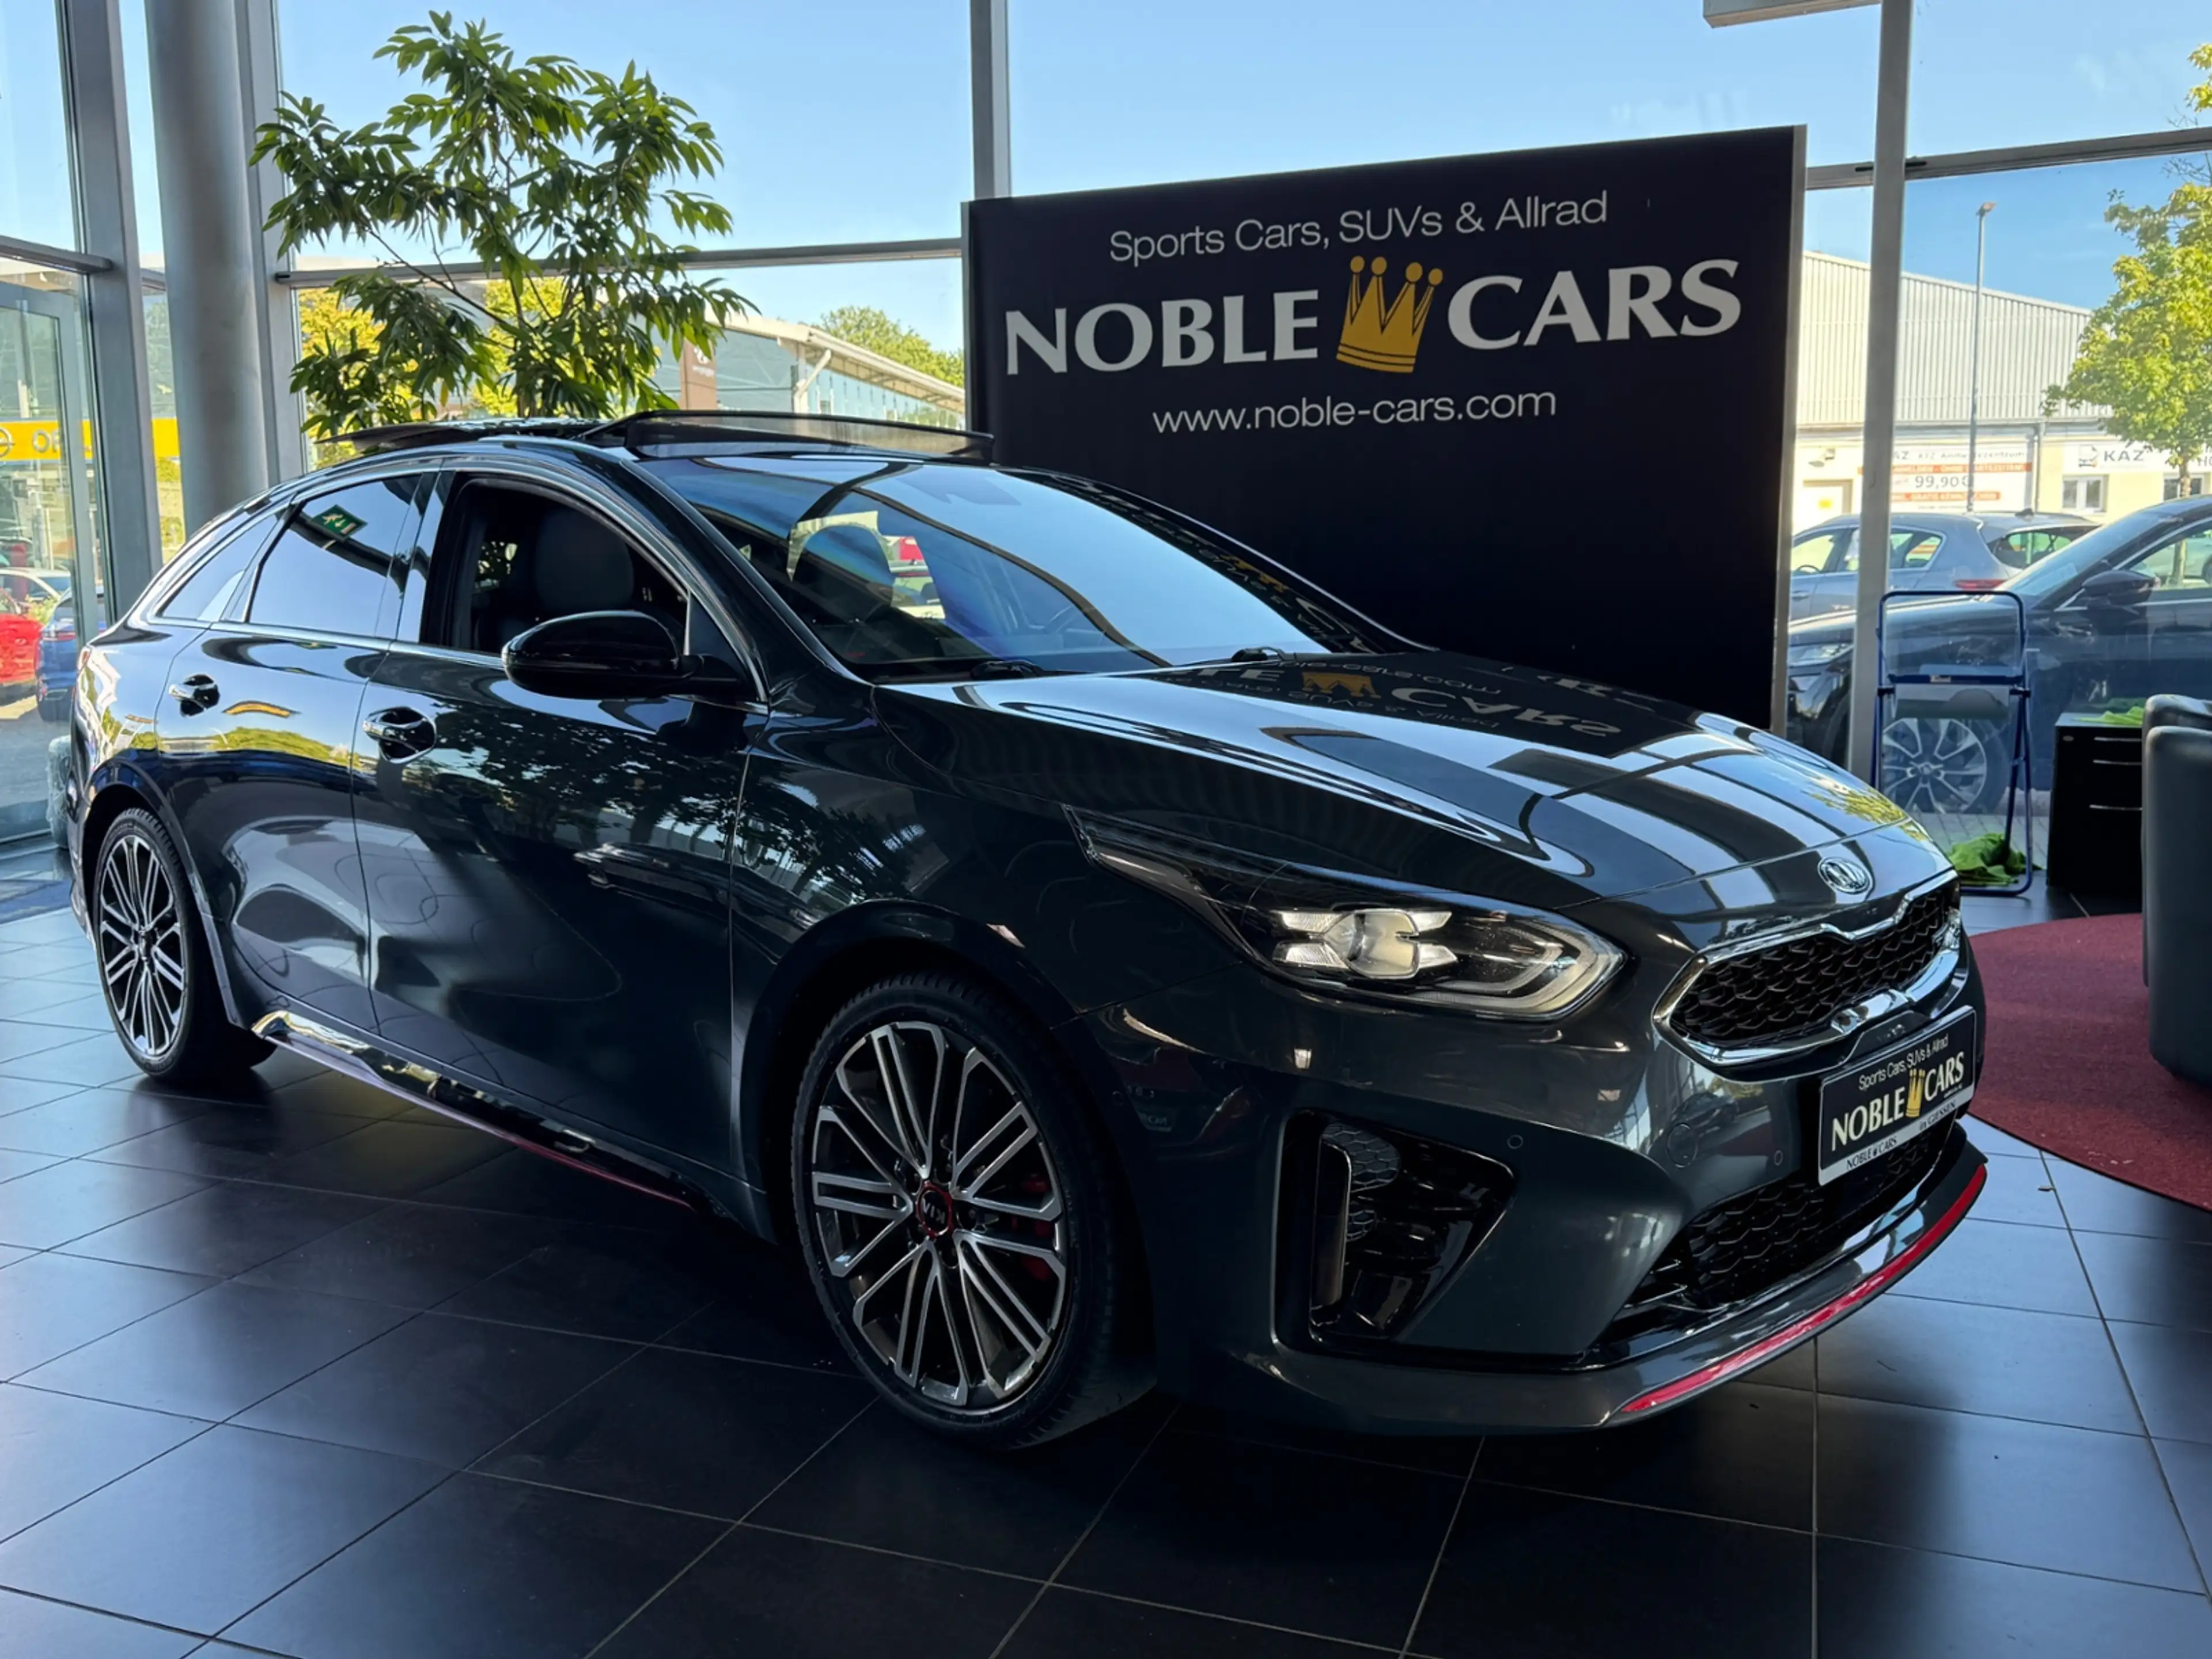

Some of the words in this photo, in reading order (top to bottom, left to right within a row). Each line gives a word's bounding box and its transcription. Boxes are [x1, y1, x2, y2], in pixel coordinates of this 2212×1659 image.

[1110, 225, 1225, 267] Sports
[1236, 219, 1328, 248] Cars,
[1339, 206, 1442, 242] SUVs
[1456, 202, 1484, 233] &
[1495, 190, 1607, 230] Allrad
[1006, 290, 1318, 375] NOBLE
[1448, 259, 1741, 349] CARS
[1153, 392, 1555, 433] www.noble-cars.com
[2104, 449, 2144, 461] KAZ
[1858, 1070, 1886, 1091] Sports
[1832, 1086, 1906, 1152] NOBLE
[1925, 1051, 1964, 1101] CARS
[1846, 1147, 1873, 1170] NOBLE
